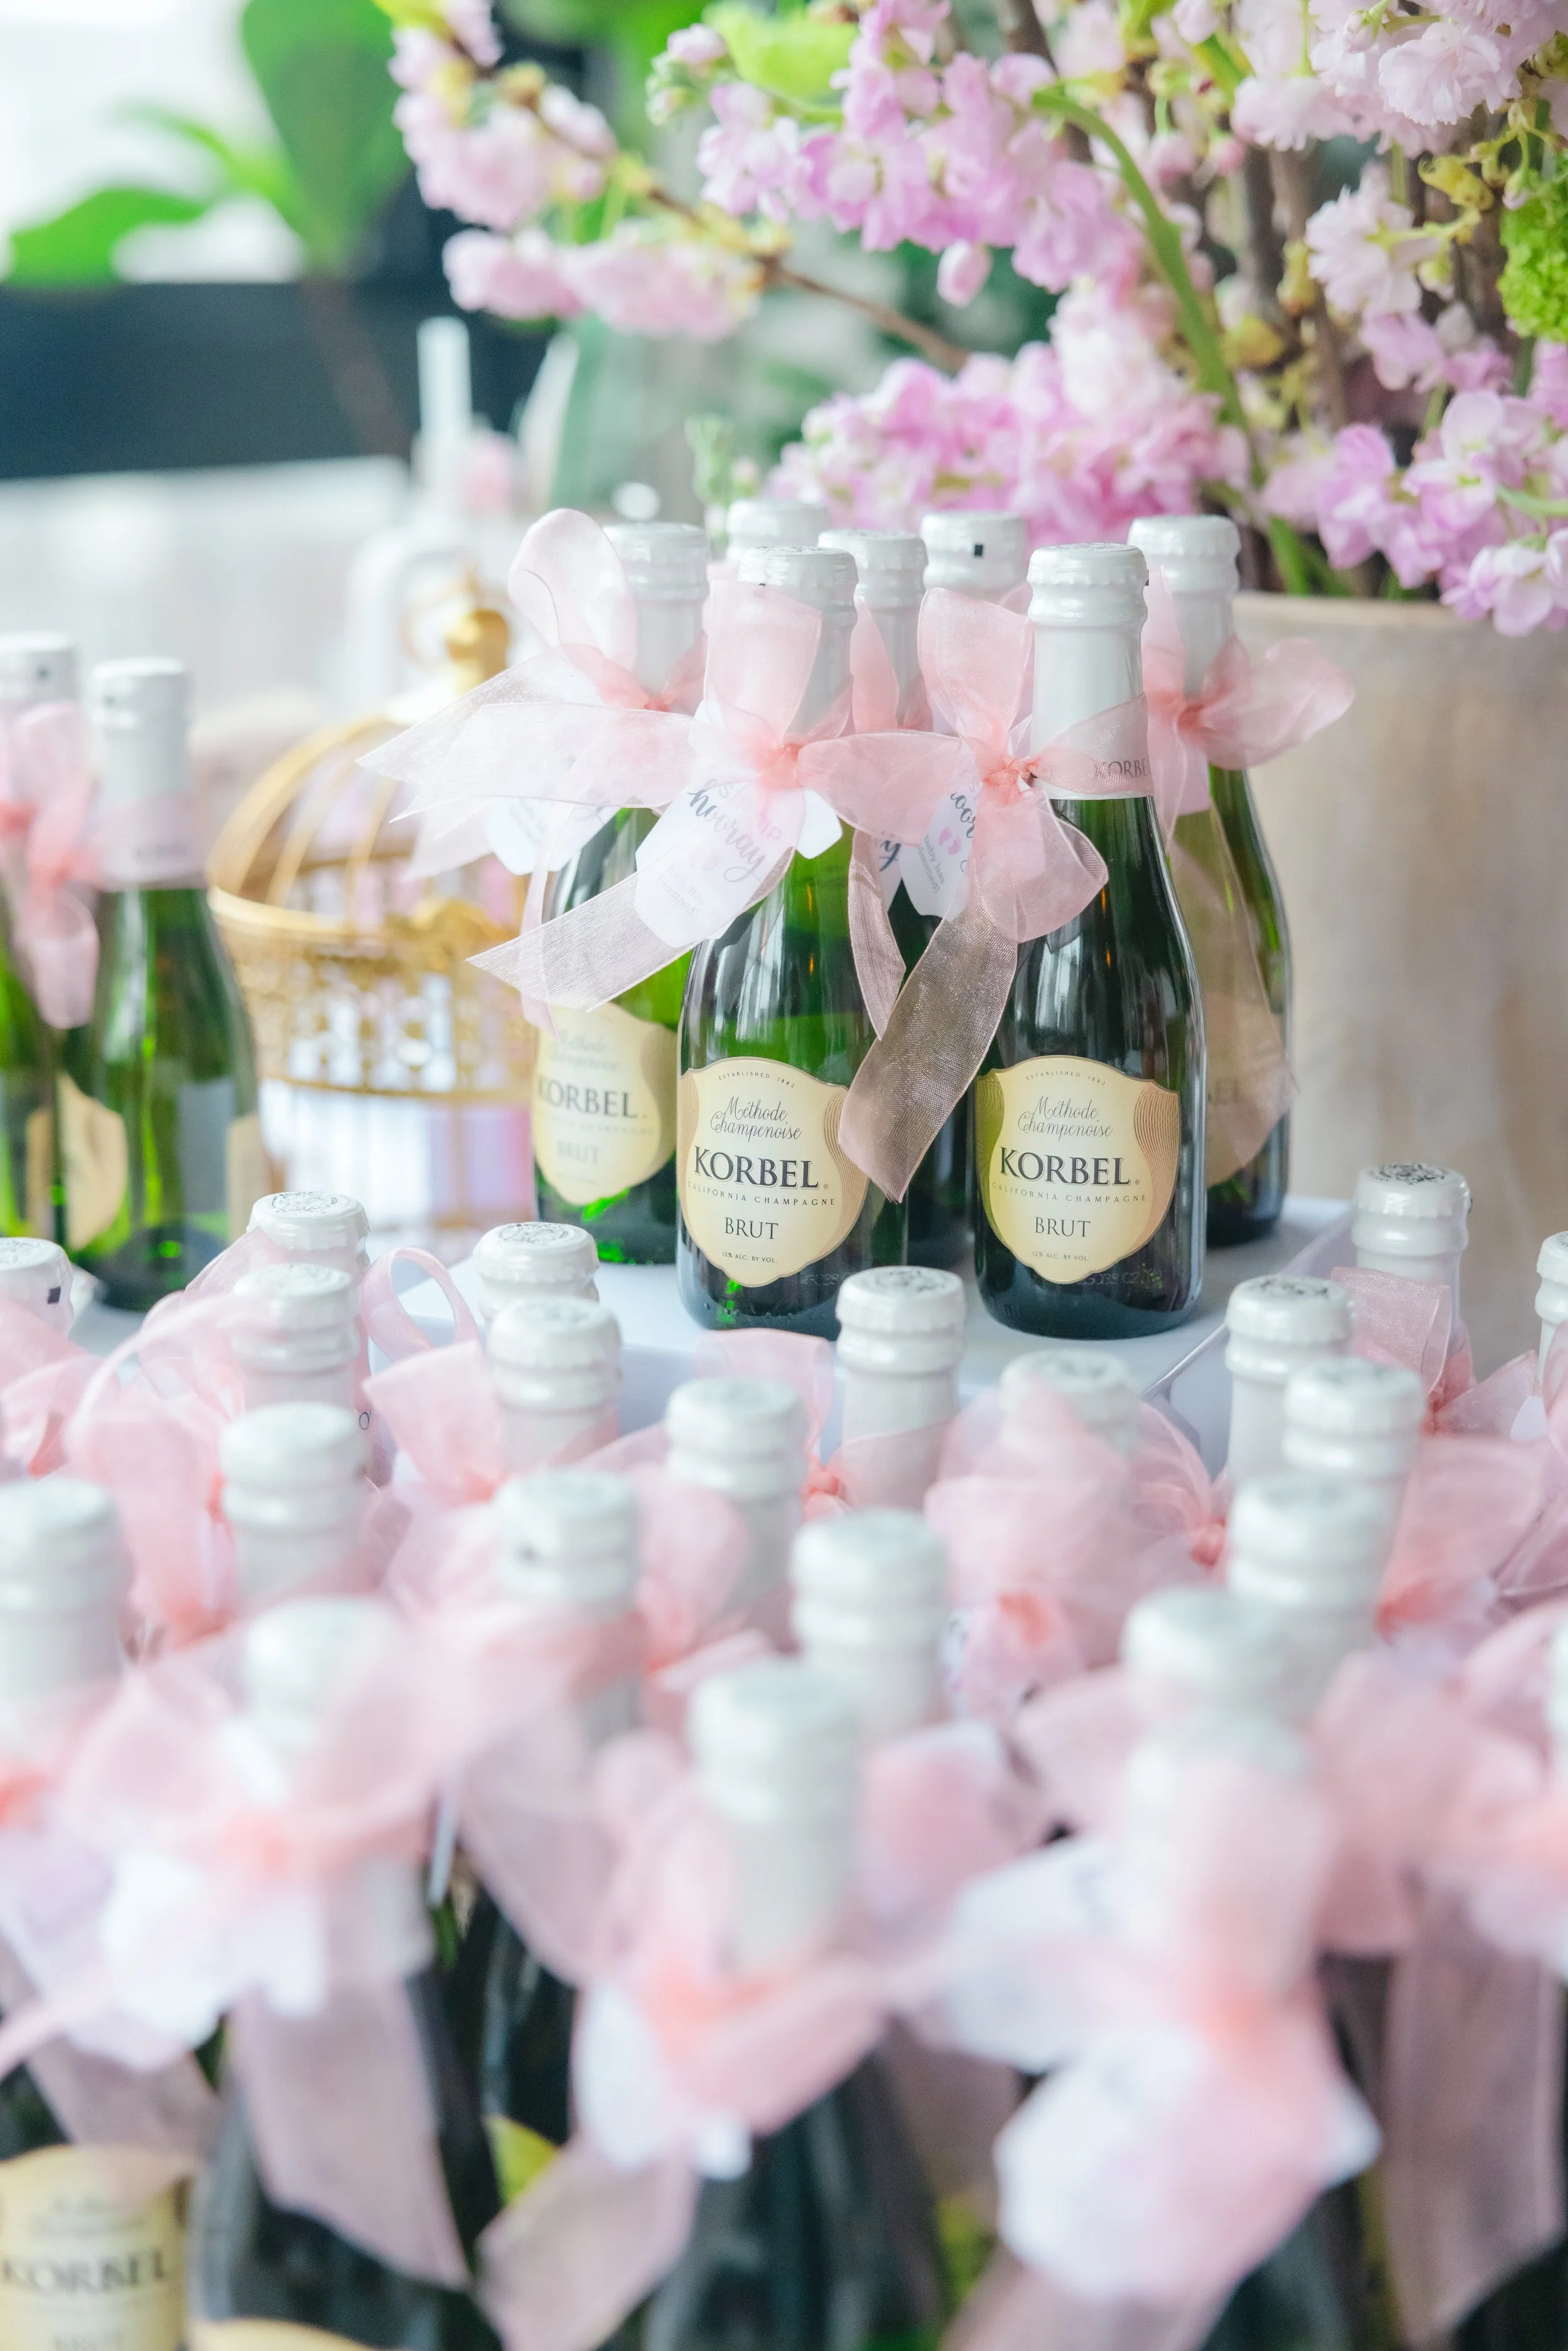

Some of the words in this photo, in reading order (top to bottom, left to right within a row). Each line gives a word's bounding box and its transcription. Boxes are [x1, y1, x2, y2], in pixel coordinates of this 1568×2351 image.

[718, 1071, 770, 1081] ESTABLISHED
[777, 1076, 795, 1088] 1882
[1026, 1070, 1081, 1081] ESTABLISHED
[1088, 1075, 1106, 1086] 1882
[723, 1096, 788, 1121] Méthode
[1035, 1096, 1099, 1120] Méthode
[710, 1111, 803, 1142] Champenoise
[1017, 1111, 1113, 1141] Champenoise
[687, 1181, 746, 1202] CALIFORNIA
[755, 1196, 835, 1206] CHAMPAGNE
[992, 1181, 1058, 1201] CALIFORNIA
[1066, 1194, 1147, 1203] CHAMPAGNE
[724, 1217, 779, 1240] BRUT
[1034, 1216, 1091, 1238] BRUT
